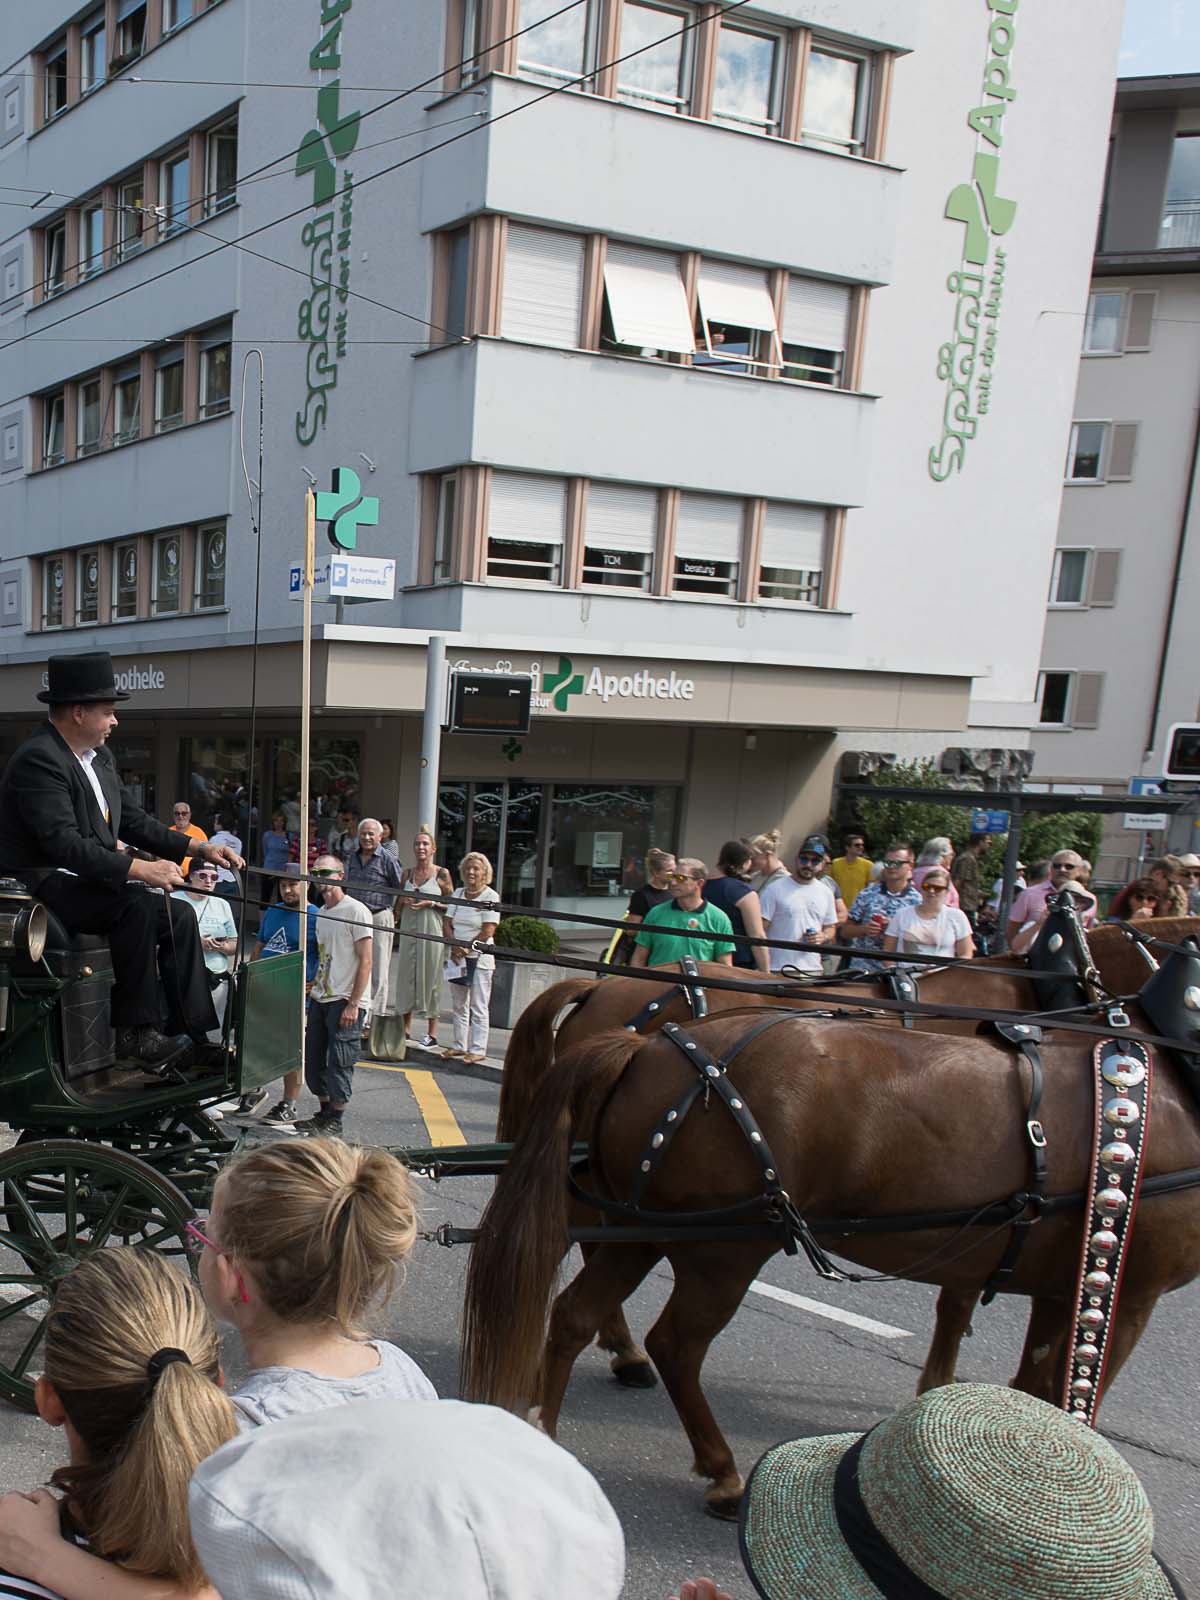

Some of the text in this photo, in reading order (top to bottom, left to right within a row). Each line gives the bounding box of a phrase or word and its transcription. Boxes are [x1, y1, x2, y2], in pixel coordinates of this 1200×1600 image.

[334, 169, 354, 358] mit der Natur
[295, 210, 339, 447] Späni
[975, 245, 1008, 415] mit der Natur
[928, 273, 986, 482] Späni
[291, 572, 300, 587] P
[334, 566, 346, 582] P
[351, 576, 387, 586] Apotheke
[114, 664, 165, 691] potheke
[585, 666, 695, 703] Apotheke
[530, 694, 551, 708] atur
